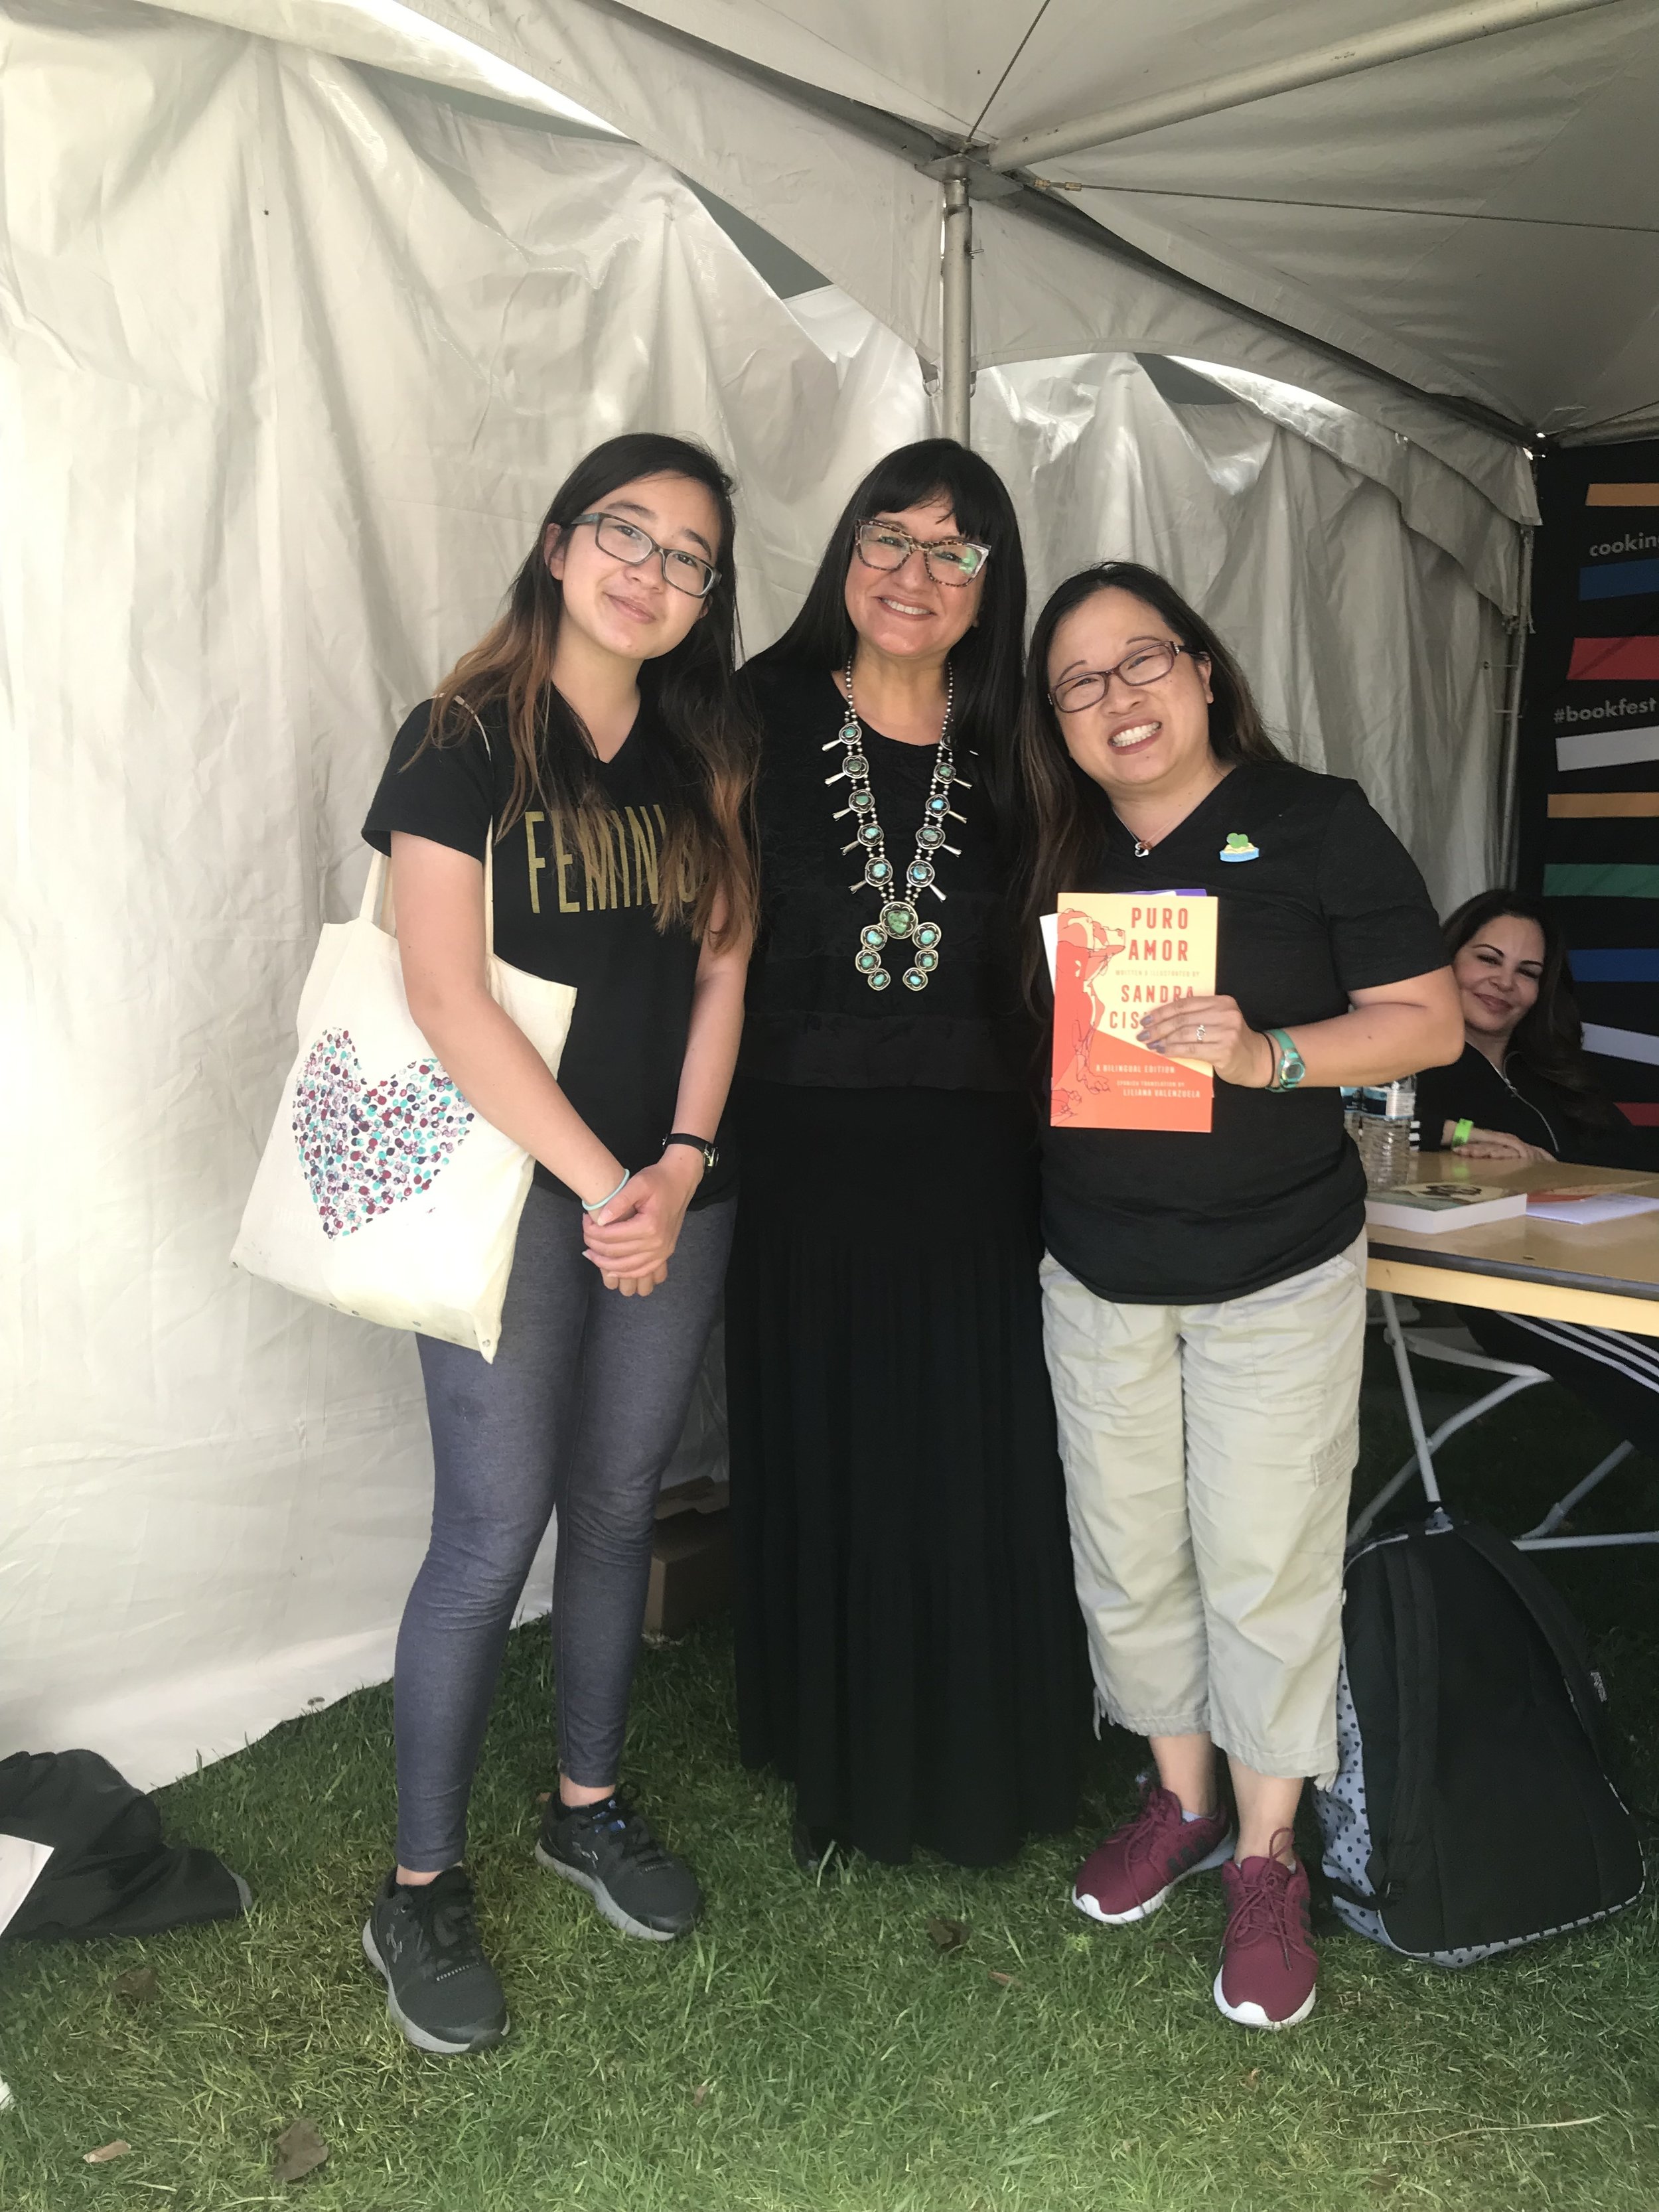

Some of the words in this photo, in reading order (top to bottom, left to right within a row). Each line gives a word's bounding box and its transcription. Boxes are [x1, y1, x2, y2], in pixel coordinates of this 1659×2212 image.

[1590, 532, 1659, 557] cookin
[1553, 698, 1656, 723] #bookfest
[1131, 907, 1189, 929] PURO
[1128, 940, 1189, 961] AMOR
[1121, 984, 1194, 1003] SANDRA
